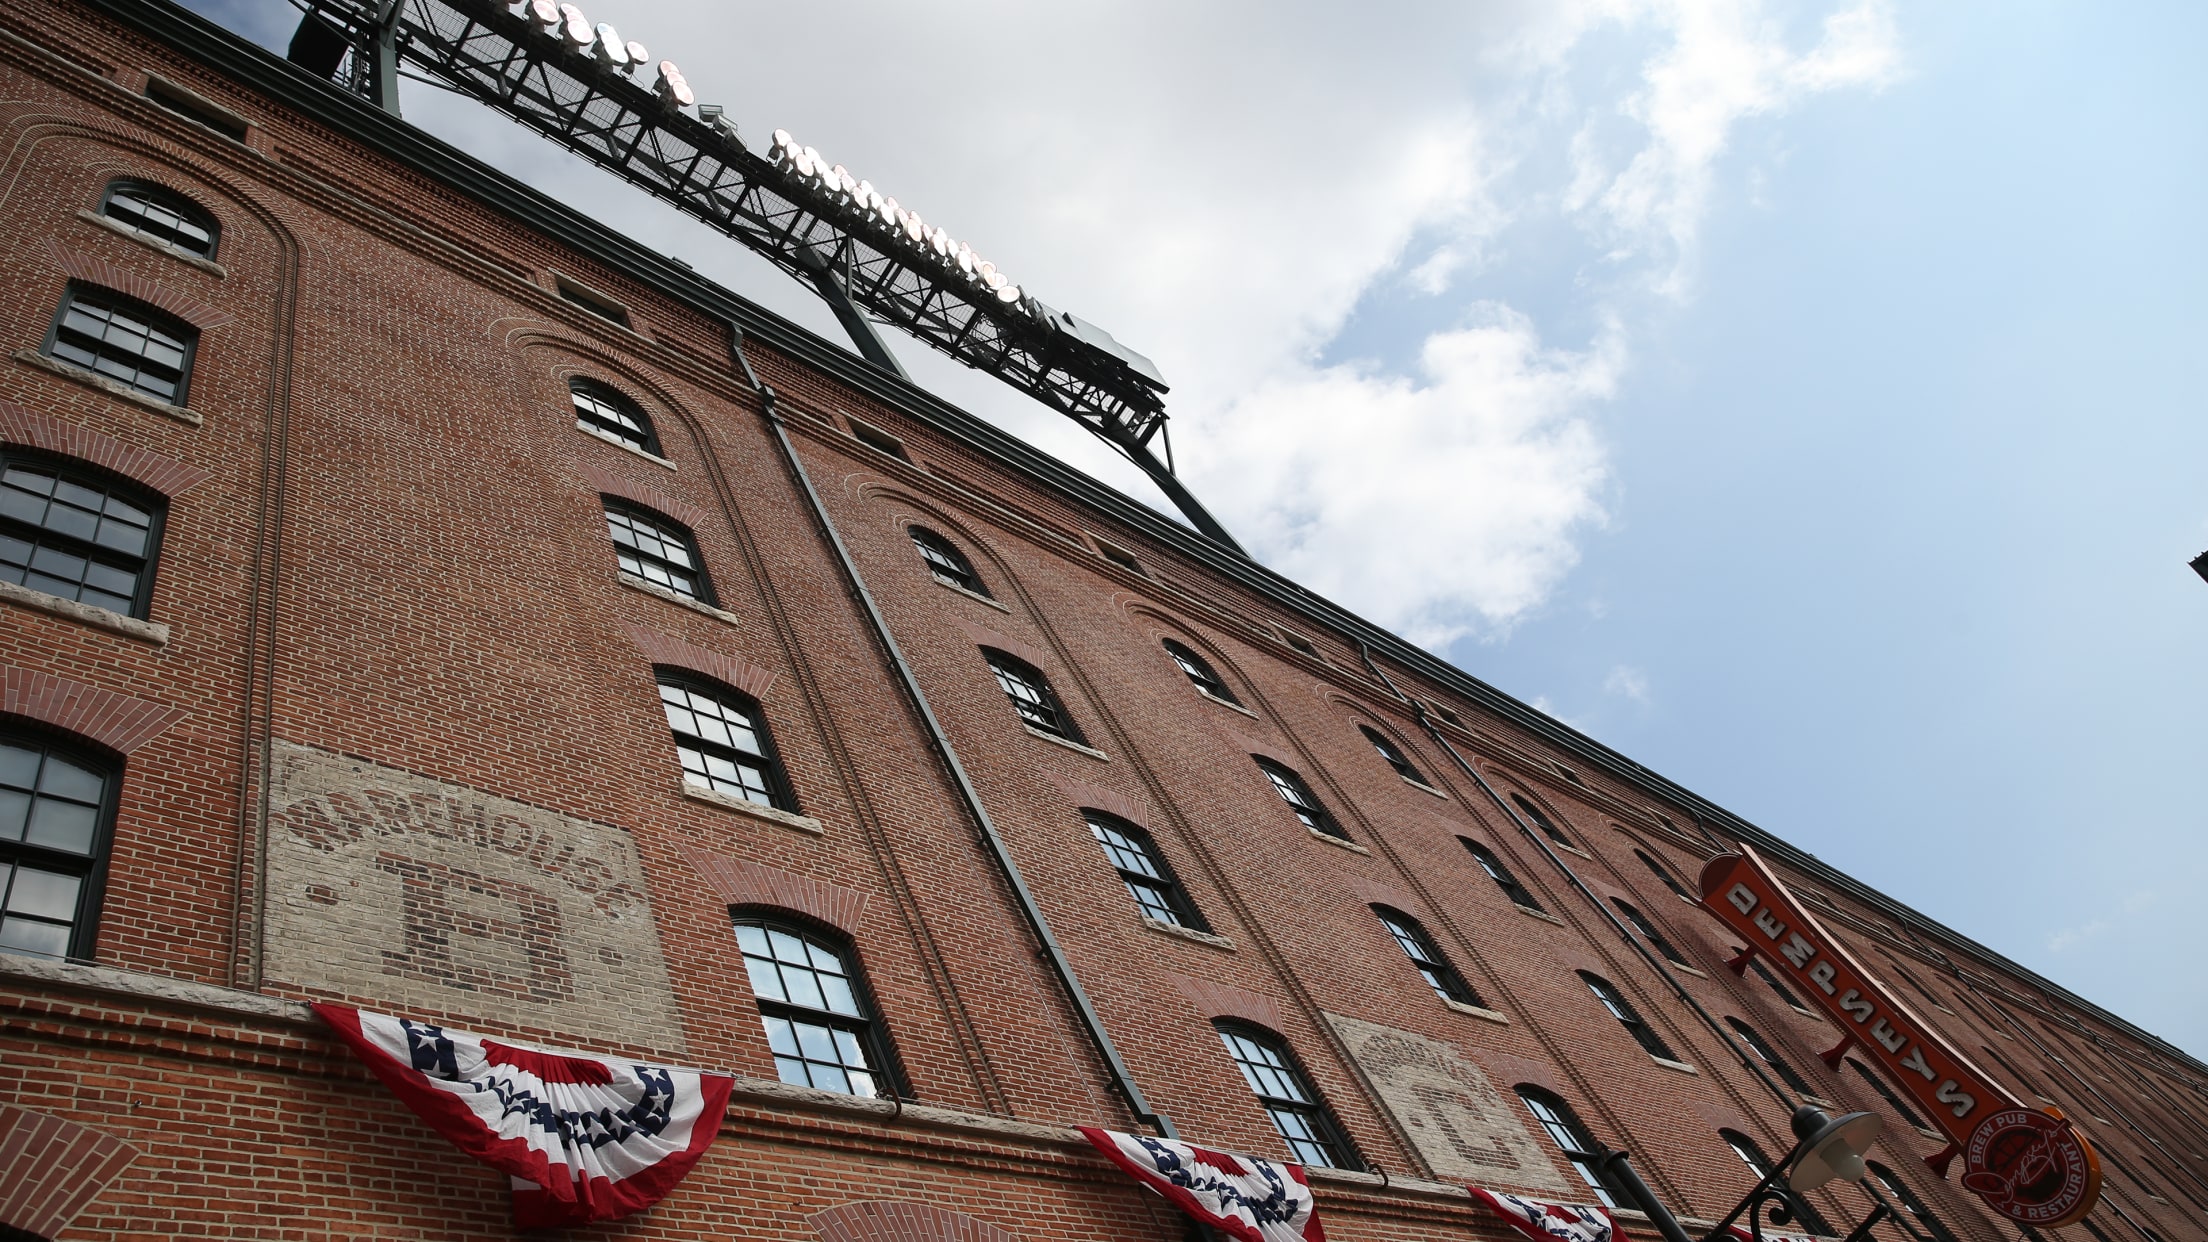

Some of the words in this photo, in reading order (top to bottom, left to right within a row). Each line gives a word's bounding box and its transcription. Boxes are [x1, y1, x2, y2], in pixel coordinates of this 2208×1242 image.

[376, 851, 575, 1002] B
[1725, 882, 1975, 1118] DEMPSEYS
[1410, 1084, 1521, 1170] C
[1971, 1123, 1994, 1164] BREW
[1996, 1114, 2027, 1127] PUB
[2012, 1205, 2022, 1215] &
[2028, 1142, 2081, 1218] RESTAURANT
